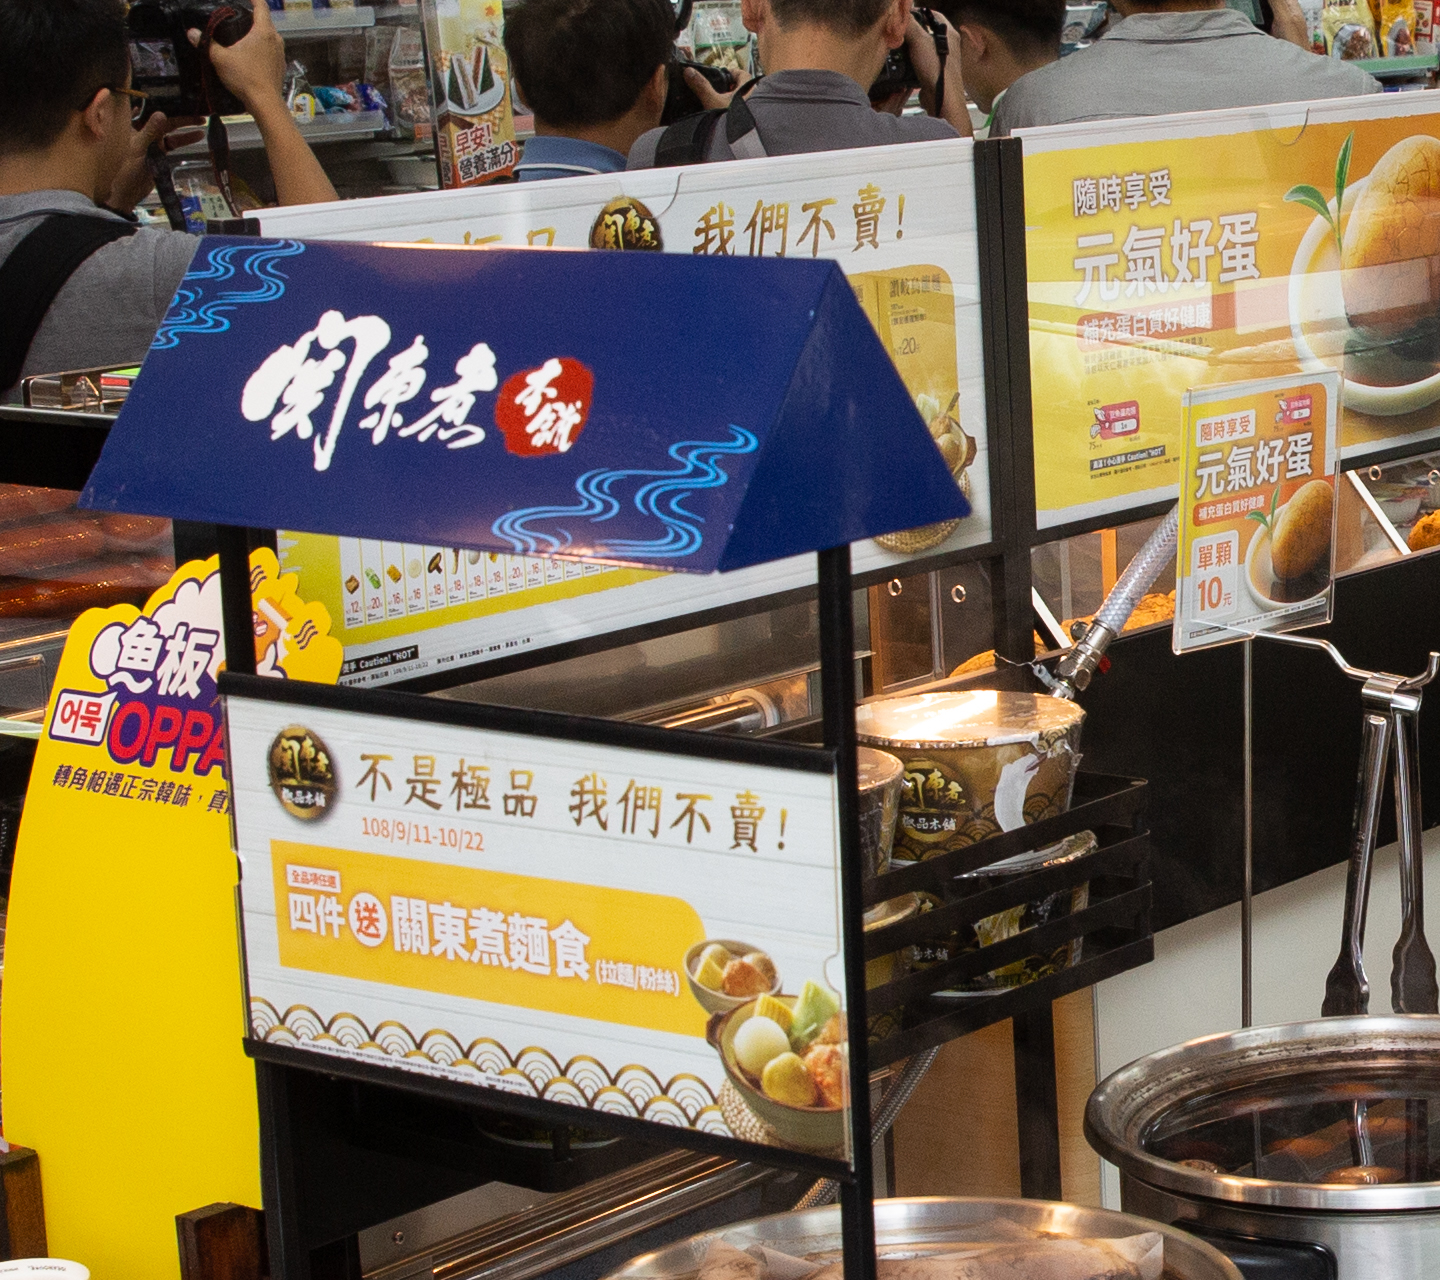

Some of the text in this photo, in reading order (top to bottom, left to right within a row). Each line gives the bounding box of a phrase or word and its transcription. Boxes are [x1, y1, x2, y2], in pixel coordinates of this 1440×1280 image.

[456, 123, 493, 156] 早安!
[460, 140, 515, 182] 營養滿分
[1072, 168, 1172, 218] 隨時享受
[692, 182, 907, 259] 我們不賣!
[1071, 210, 1262, 307] 元氣好蛋
[1083, 301, 1212, 346] 補充蛋白質好健康
[1200, 414, 1252, 442] 隨時享受
[1195, 432, 1313, 499] 元氣好蛋
[1198, 495, 1265, 521] 補充蛋白質好健康
[1197, 540, 1233, 571] 單顆
[60, 699, 103, 738] 어묵
[355, 751, 789, 854] 不是極品 我們不賣!
[361, 816, 485, 854] 108/9/11-10/22
